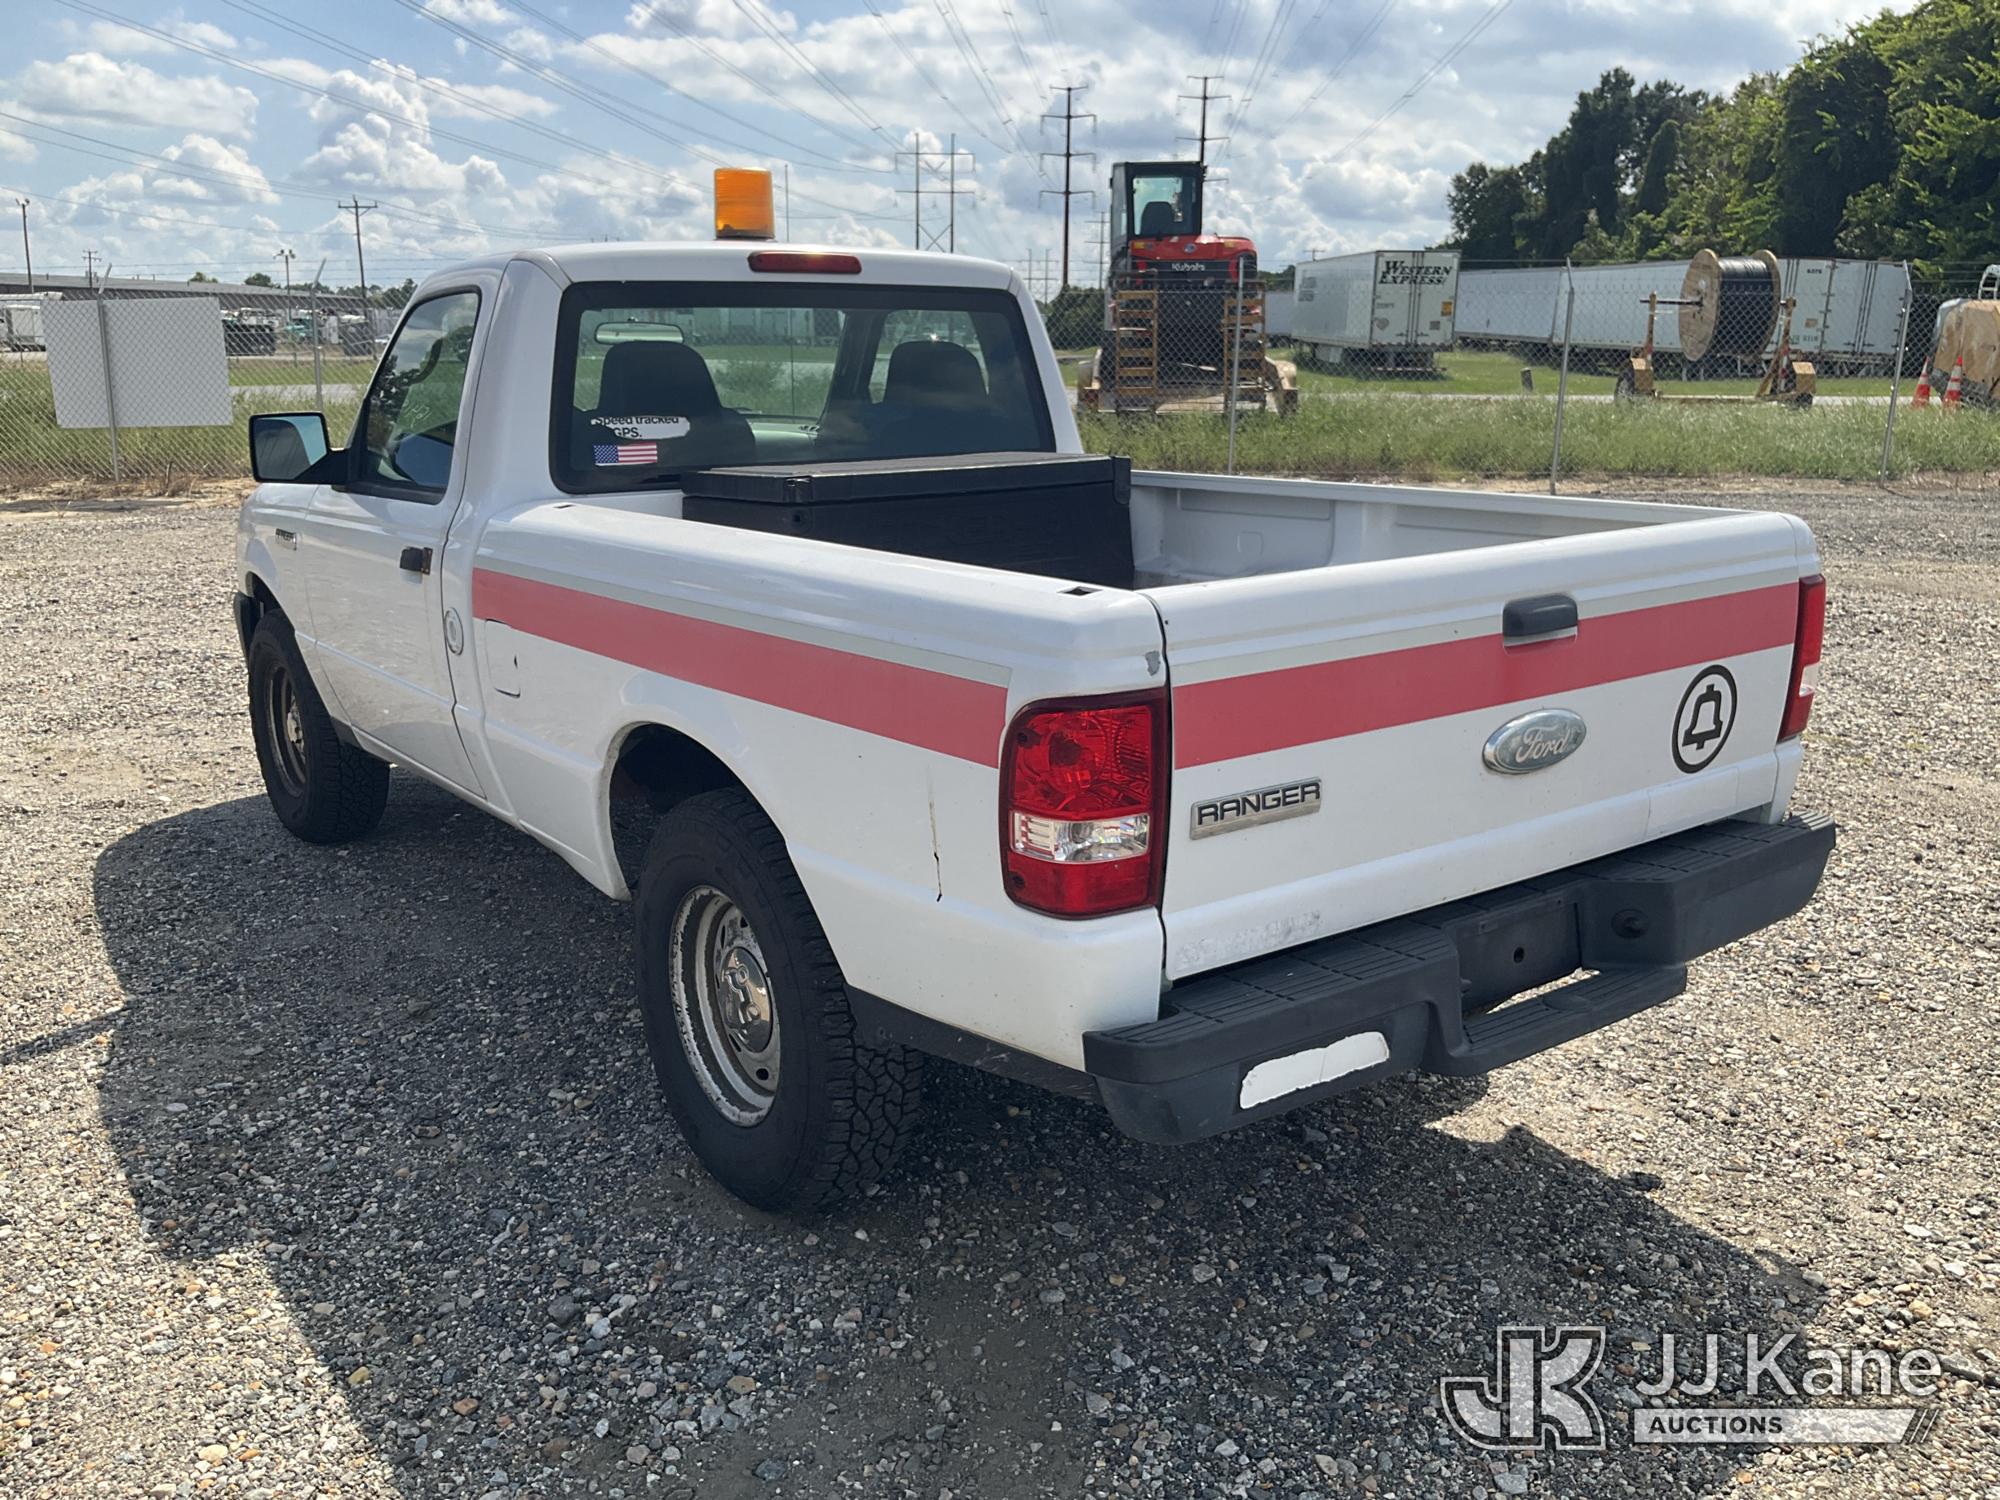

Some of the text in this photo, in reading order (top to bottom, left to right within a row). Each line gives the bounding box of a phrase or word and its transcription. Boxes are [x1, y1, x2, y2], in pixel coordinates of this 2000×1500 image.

[1171, 263, 1206, 272] Kubota
[1384, 260, 1453, 276] WESTERN
[595, 416, 679, 426] Speed tracked
[1514, 724, 1571, 763] Ford
[1196, 781, 1322, 826] RANGER
